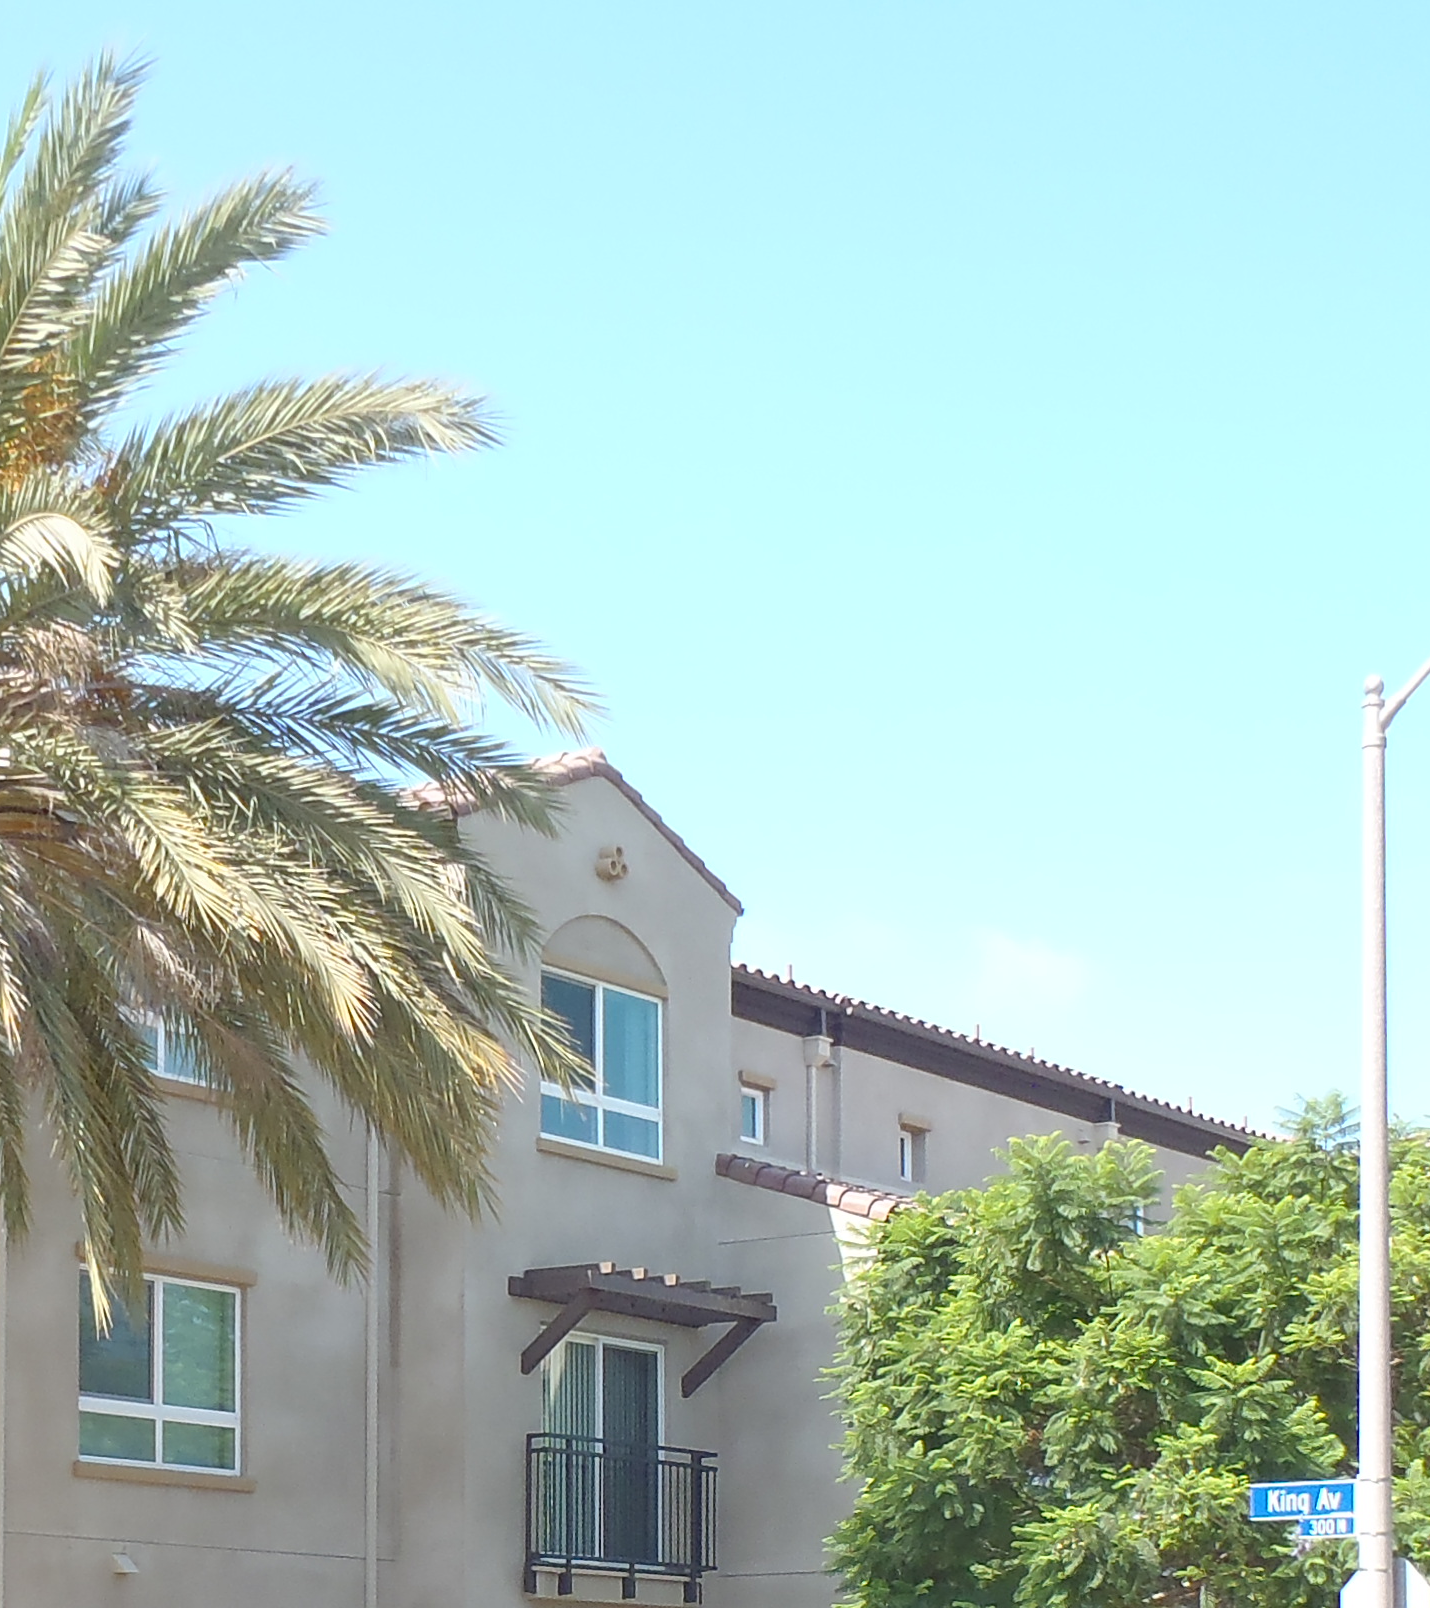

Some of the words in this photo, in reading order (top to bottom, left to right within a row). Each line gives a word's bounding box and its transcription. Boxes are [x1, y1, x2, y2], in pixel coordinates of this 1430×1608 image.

[1267, 1489, 1310, 1515] King
[1316, 1487, 1341, 1511] Av
[1308, 1519, 1335, 1535] 300
